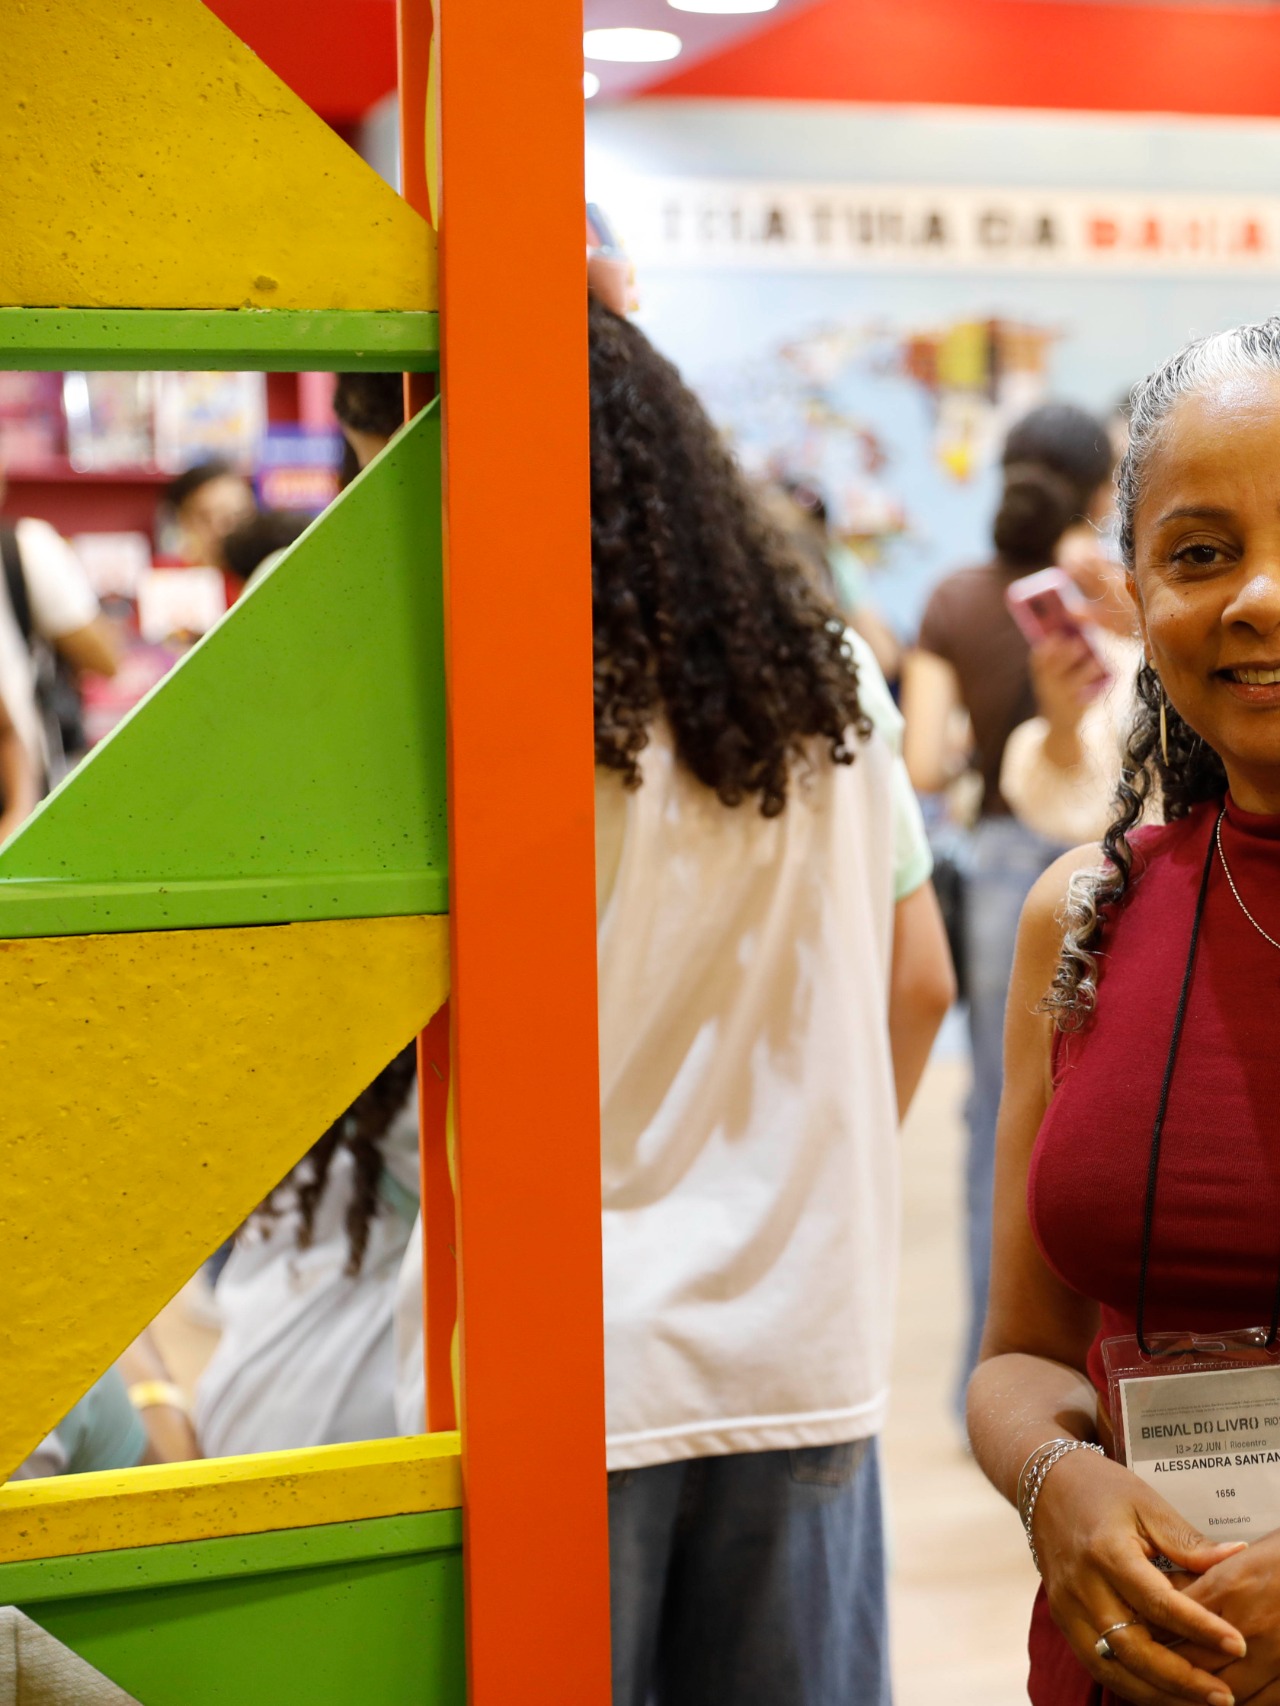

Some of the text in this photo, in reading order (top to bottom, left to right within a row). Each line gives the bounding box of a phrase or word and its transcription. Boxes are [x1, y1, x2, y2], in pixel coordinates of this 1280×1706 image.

[1141, 1421, 1192, 1440] BIENAL
[1217, 1416, 1259, 1433] LIVRO
[1175, 1444, 1185, 1455] 13
[1193, 1442, 1204, 1453] 22
[1205, 1441, 1221, 1452] JUN
[1230, 1438, 1267, 1450] Riocentro
[1154, 1456, 1232, 1473] ALESSANDRA
[1215, 1488, 1236, 1499] 1656
[1208, 1515, 1251, 1526] Bibliotecário
